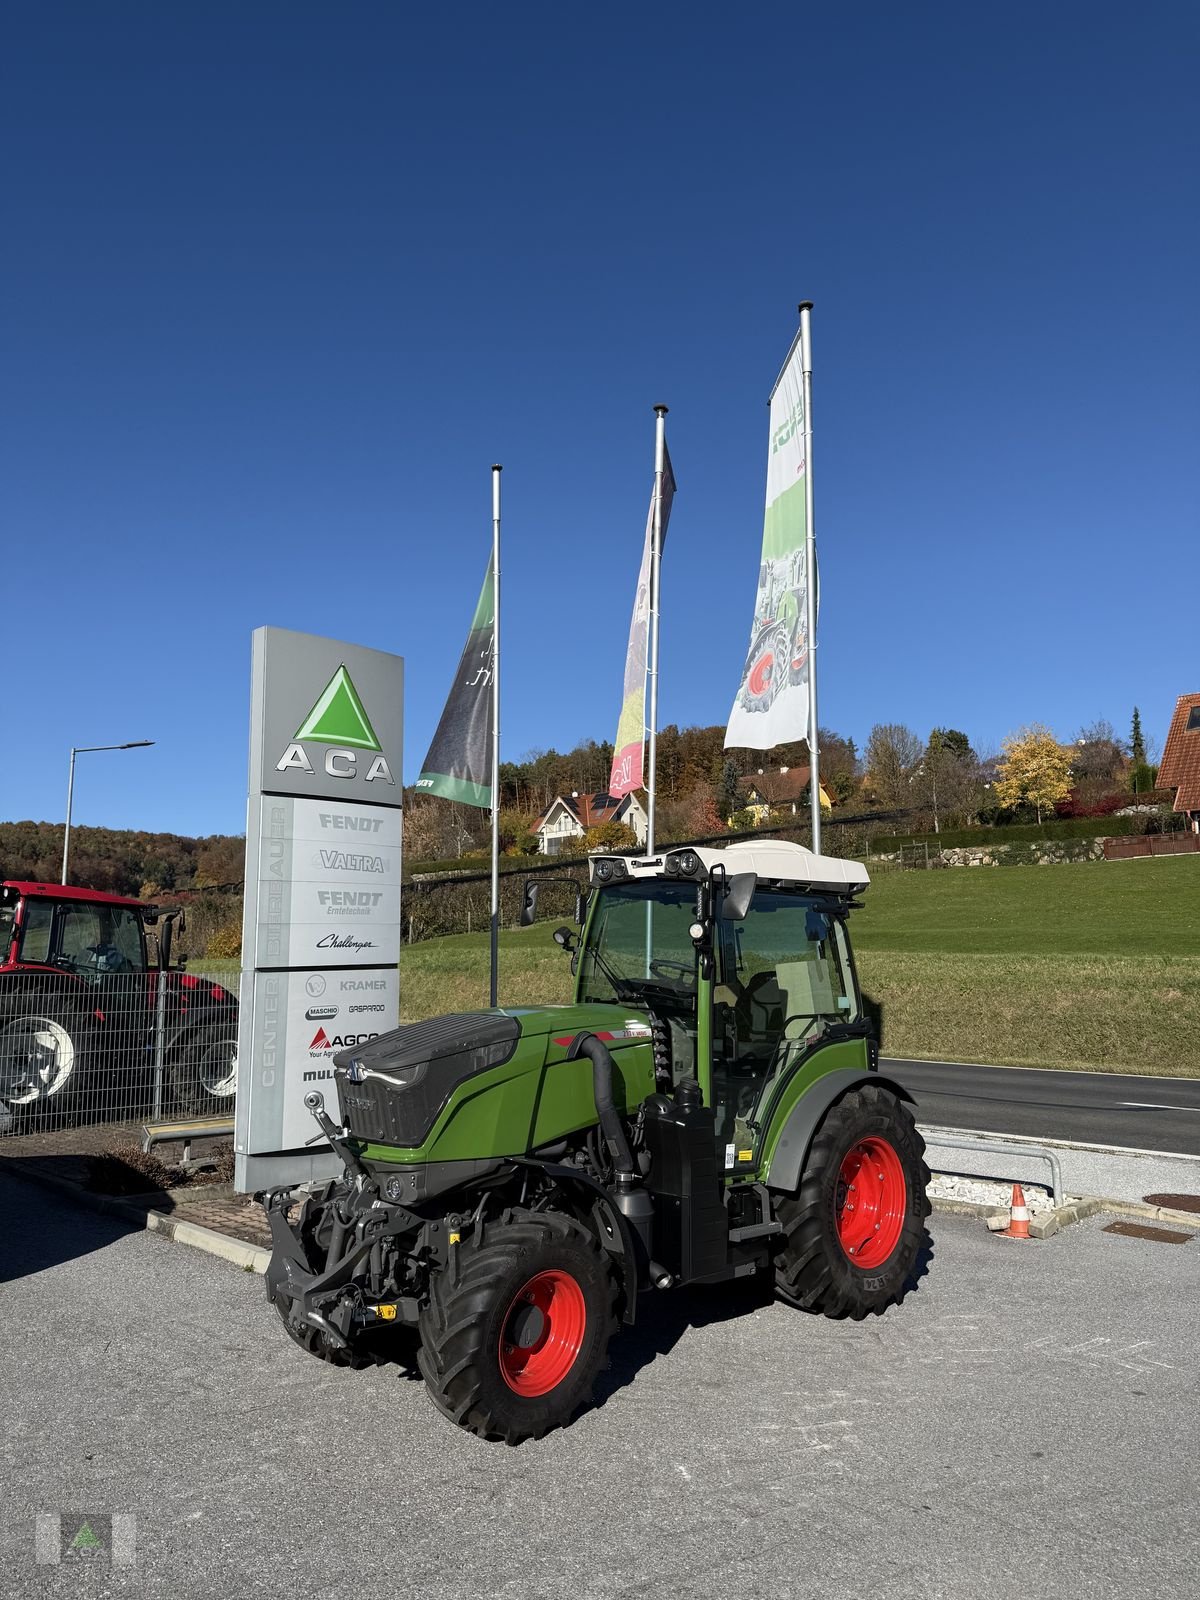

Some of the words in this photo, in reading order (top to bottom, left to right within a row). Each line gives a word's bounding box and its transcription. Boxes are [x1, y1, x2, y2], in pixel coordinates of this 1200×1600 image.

[274, 743, 395, 785] ACA
[319, 813, 384, 833] FENDT
[319, 850, 384, 873] VALTRA
[267, 807, 286, 957] BIERBAUER
[317, 890, 383, 907] FENDT
[327, 906, 371, 915] Erntetechnik
[316, 934, 380, 953] Challenger
[340, 980, 387, 991] KRAMER
[349, 1005, 385, 1013] GASPARDO
[262, 978, 280, 1087] CENTER
